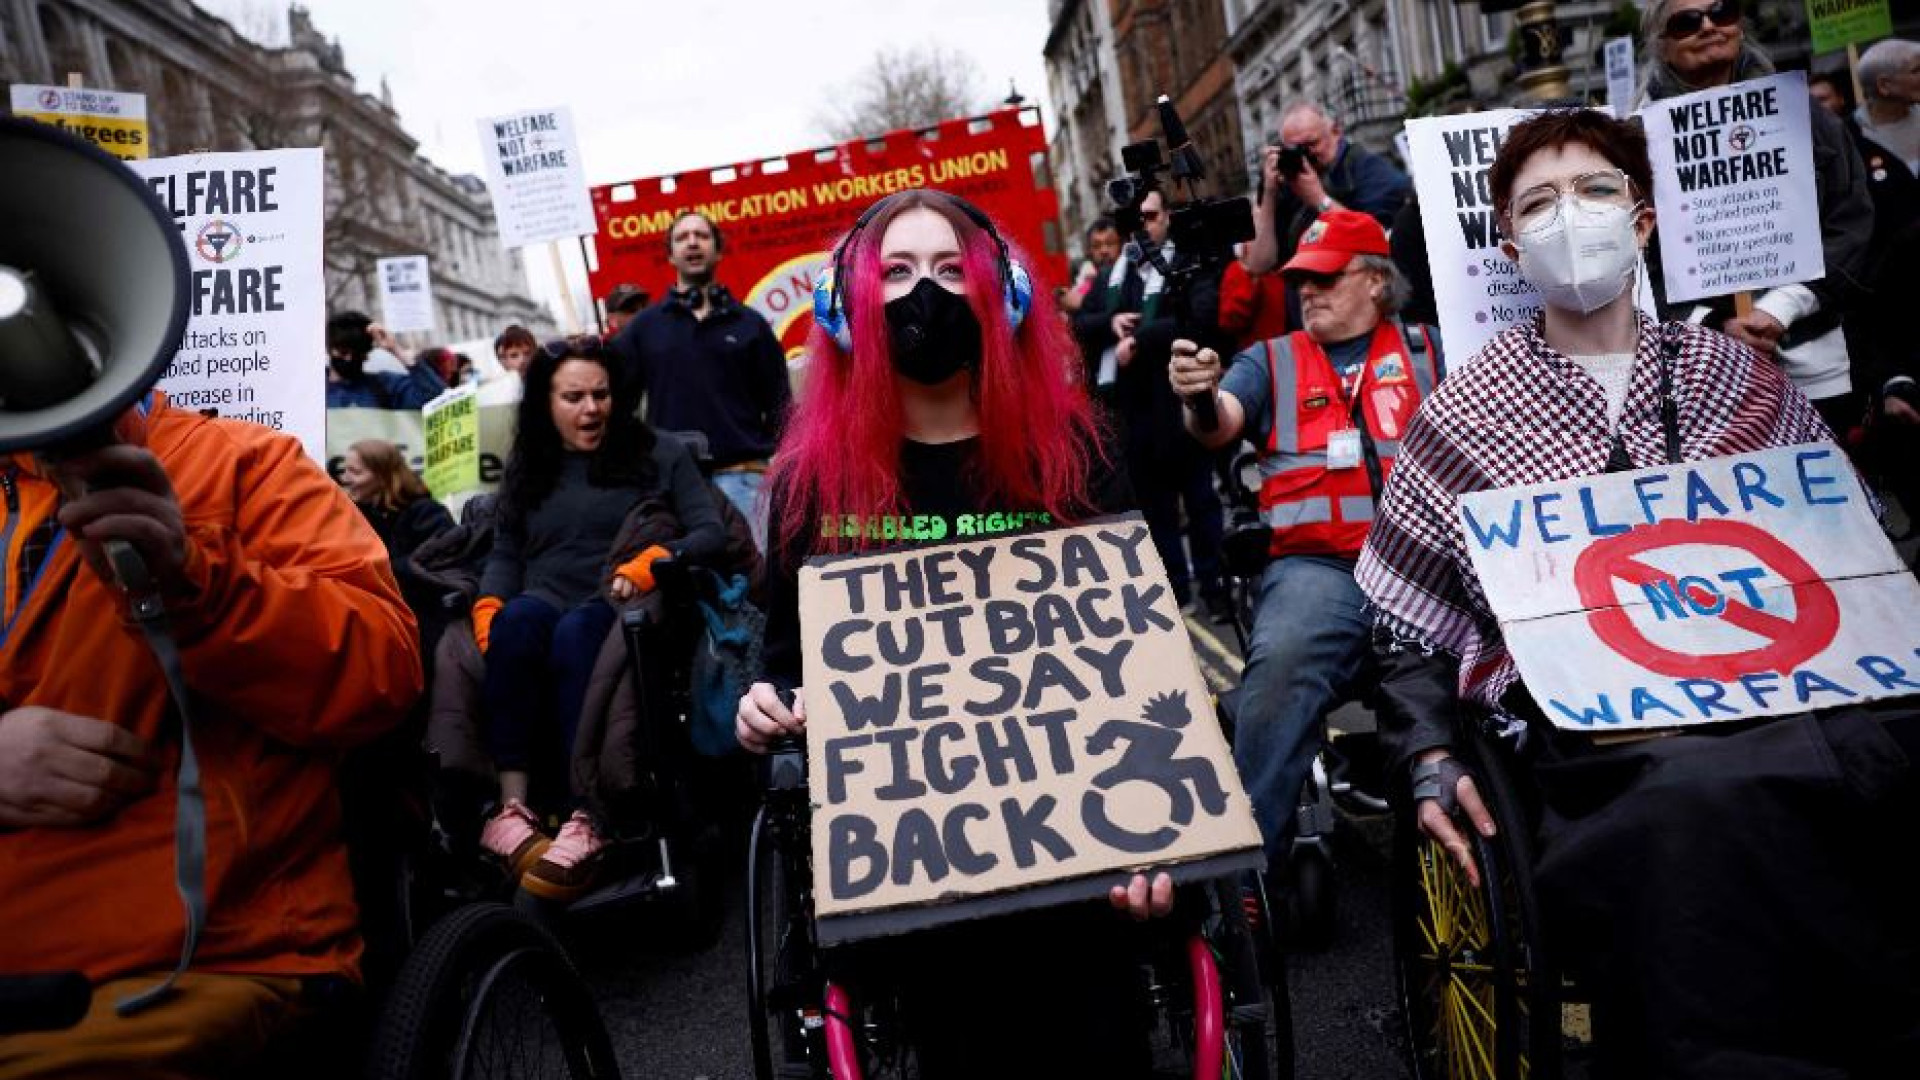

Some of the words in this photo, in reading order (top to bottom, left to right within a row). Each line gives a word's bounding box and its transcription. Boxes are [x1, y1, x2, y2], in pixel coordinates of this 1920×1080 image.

[493, 113, 558, 138] WELFARE
[1668, 86, 1779, 134] WELFARE
[497, 137, 526, 157] NOT
[501, 150, 568, 177] WARFARE
[1672, 129, 1721, 163] NOT
[148, 166, 278, 218] ELFARE
[1451, 170, 1495, 208] NO
[1676, 147, 1789, 193] WARFARE
[1763, 187, 1779, 198] on
[608, 187, 808, 239] COMMNICATION
[812, 164, 925, 206] WORKERS
[929, 148, 1009, 183] UNION
[1763, 218, 1775, 230] in
[193, 265, 285, 315] FARE
[765, 271, 813, 312] ON
[1491, 305, 1514, 323] No
[179, 327, 238, 350] ttacks
[243, 330, 267, 347] on
[207, 350, 271, 379] people
[238, 383, 254, 401] in
[1462, 449, 1849, 550] WELFARE
[821, 546, 996, 613] THEY
[1010, 526, 1149, 593] SAY
[1641, 566, 1770, 622] NOT
[821, 605, 975, 674] CUT
[985, 583, 1175, 655] BACK
[829, 663, 951, 731] WE
[964, 639, 1135, 718] SAY
[1549, 648, 1920, 727] WARFAR
[825, 708, 1078, 805] FIGHT
[828, 794, 1077, 900] BACK
